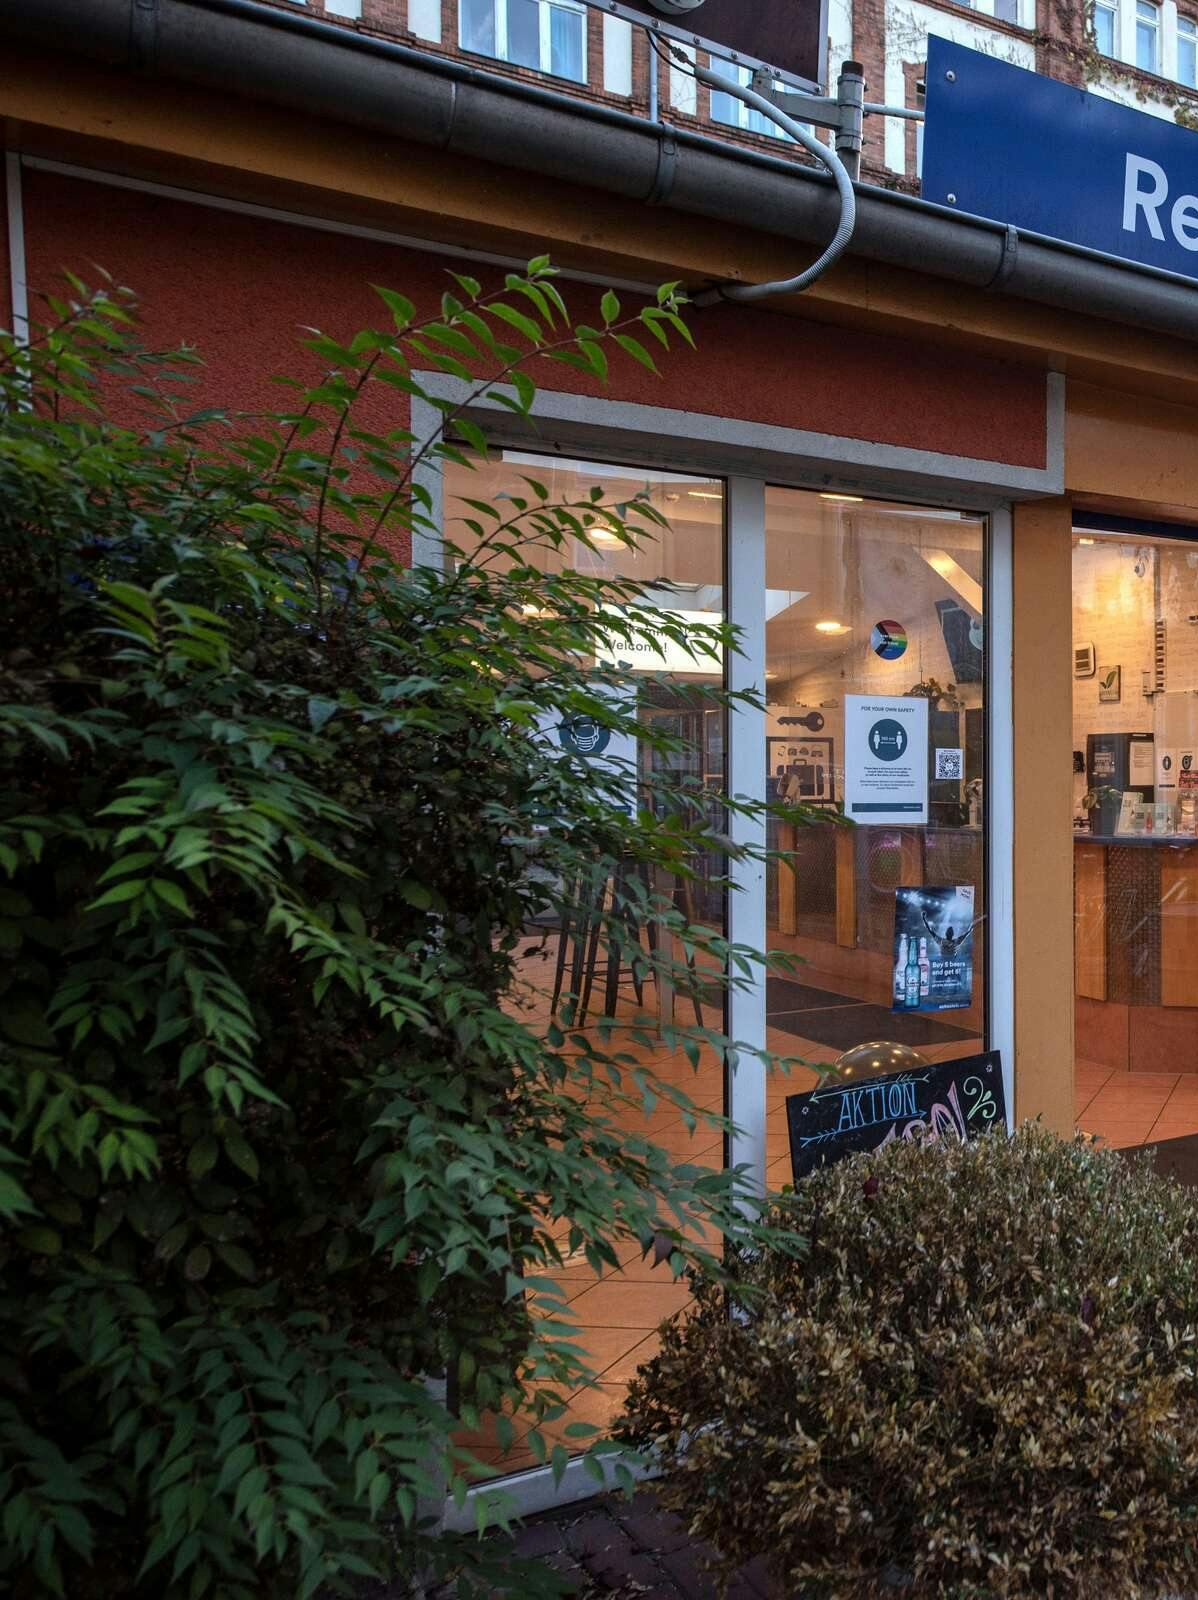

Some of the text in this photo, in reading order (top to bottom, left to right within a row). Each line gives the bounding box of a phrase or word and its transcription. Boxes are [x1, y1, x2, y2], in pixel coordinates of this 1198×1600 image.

[605, 639, 667, 653] Welcom!
[932, 961, 944, 969] Buy
[838, 1081, 919, 1131] AKTION
